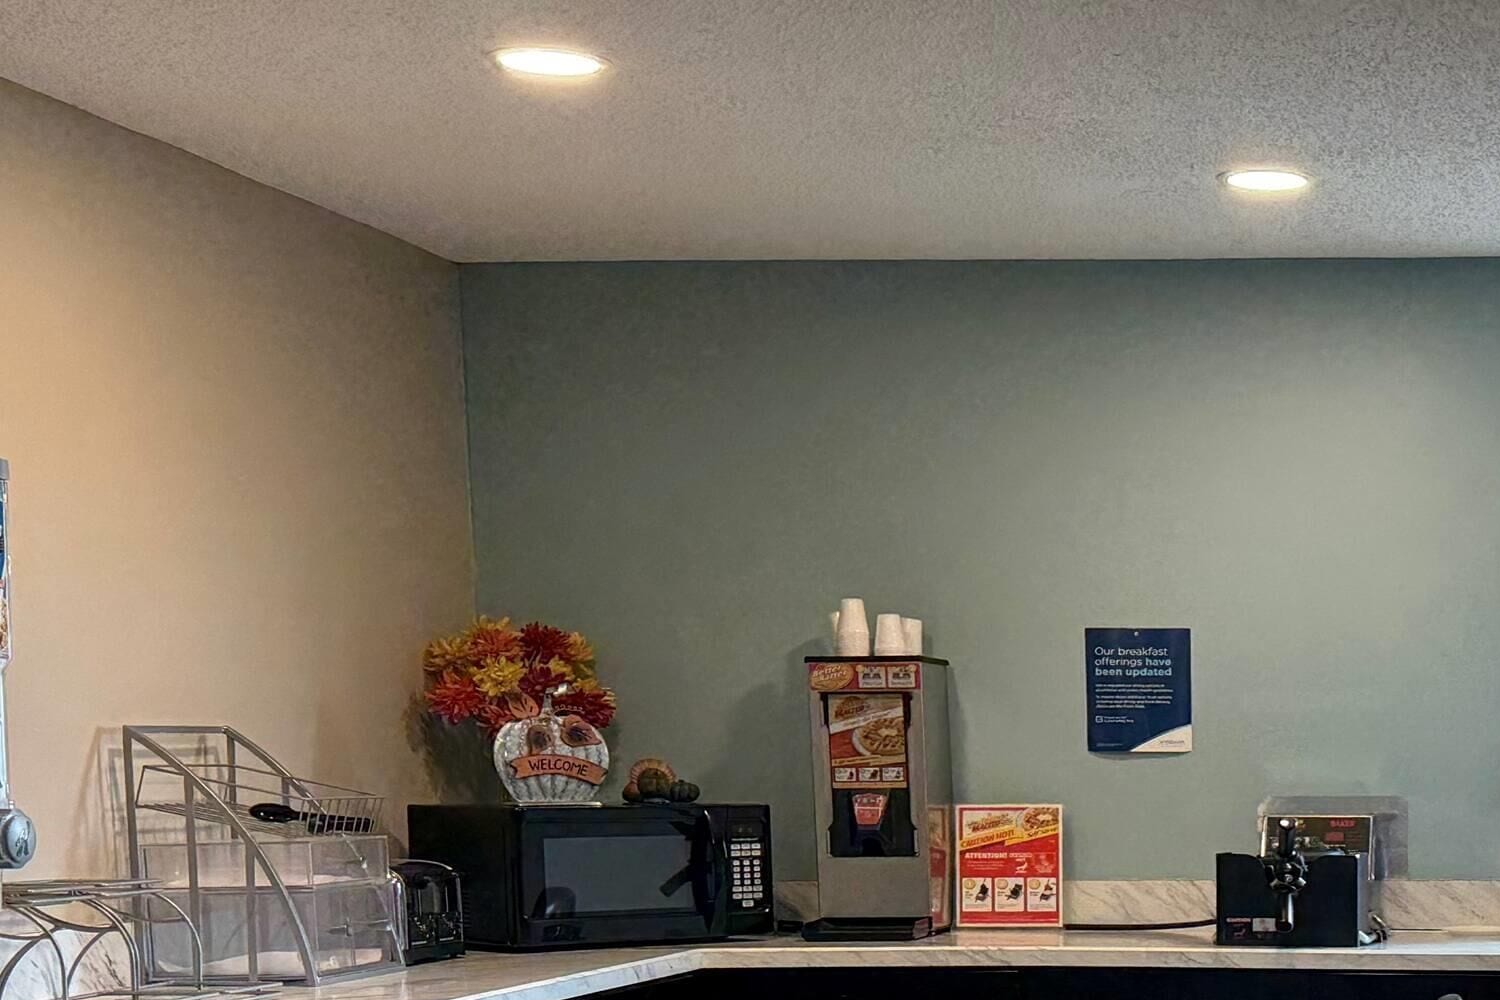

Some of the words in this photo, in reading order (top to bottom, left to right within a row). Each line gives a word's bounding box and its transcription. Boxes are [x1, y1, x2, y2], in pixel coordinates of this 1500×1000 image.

[1095, 646, 1115, 656] Our
[1118, 647, 1169, 656] breakfast
[1095, 657, 1143, 668] offerings
[1145, 658, 1172, 666] have
[1095, 667, 1122, 676] been
[1125, 667, 1172, 678] updated
[528, 759, 589, 777] WELCOME
[960, 834, 995, 848] CAUTION
